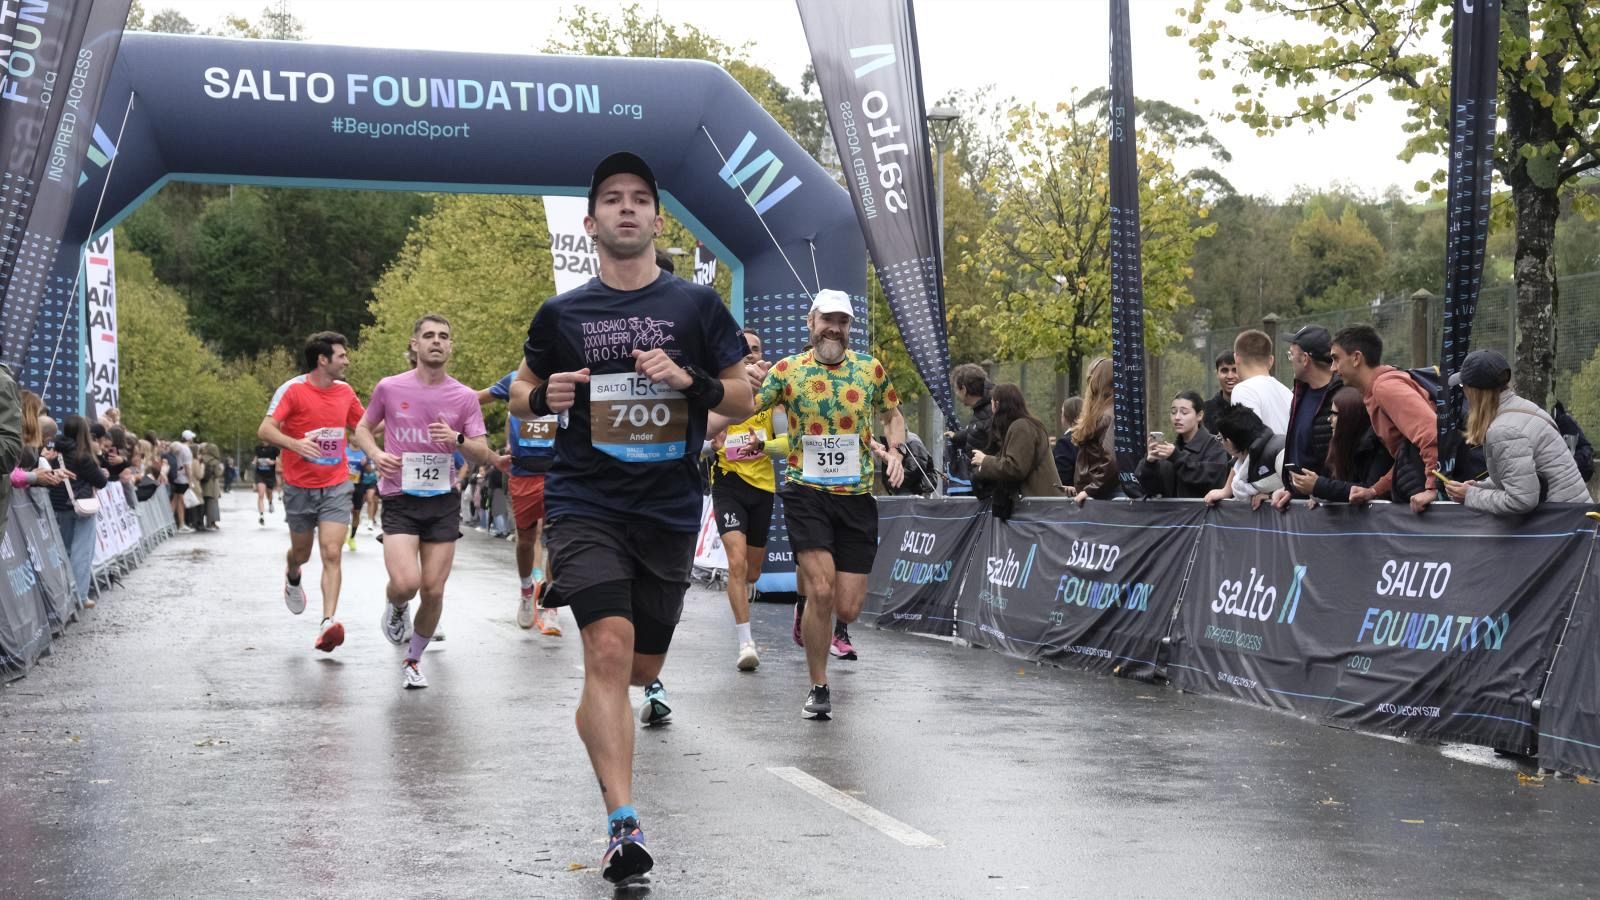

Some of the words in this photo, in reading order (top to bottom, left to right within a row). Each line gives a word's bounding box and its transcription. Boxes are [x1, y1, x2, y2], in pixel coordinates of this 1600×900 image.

[203, 66, 335, 104] SALTO
[346, 73, 601, 115] FOUNDATION
[608, 102, 643, 120] .org
[48, 113, 77, 182] INSPIRED
[67, 48, 93, 110] ACCESS
[331, 116, 471, 140] #BeyondSport
[581, 318, 627, 336] TOLOSAKO
[608, 332, 631, 345] HERRI
[597, 383, 627, 393] SALTO
[526, 422, 549, 433] 754
[611, 403, 671, 428] 700
[630, 433, 653, 441] Ander
[817, 452, 845, 466] 319
[415, 467, 440, 480] 142
[901, 530, 937, 556] SALTO
[986, 548, 1020, 588] salto
[1065, 540, 1121, 573] SALTO
[1376, 559, 1452, 599] SALTO
[1055, 574, 1155, 612] FOUNDAION
[1211, 567, 1277, 622] salto
[1346, 655, 1373, 675] .org
